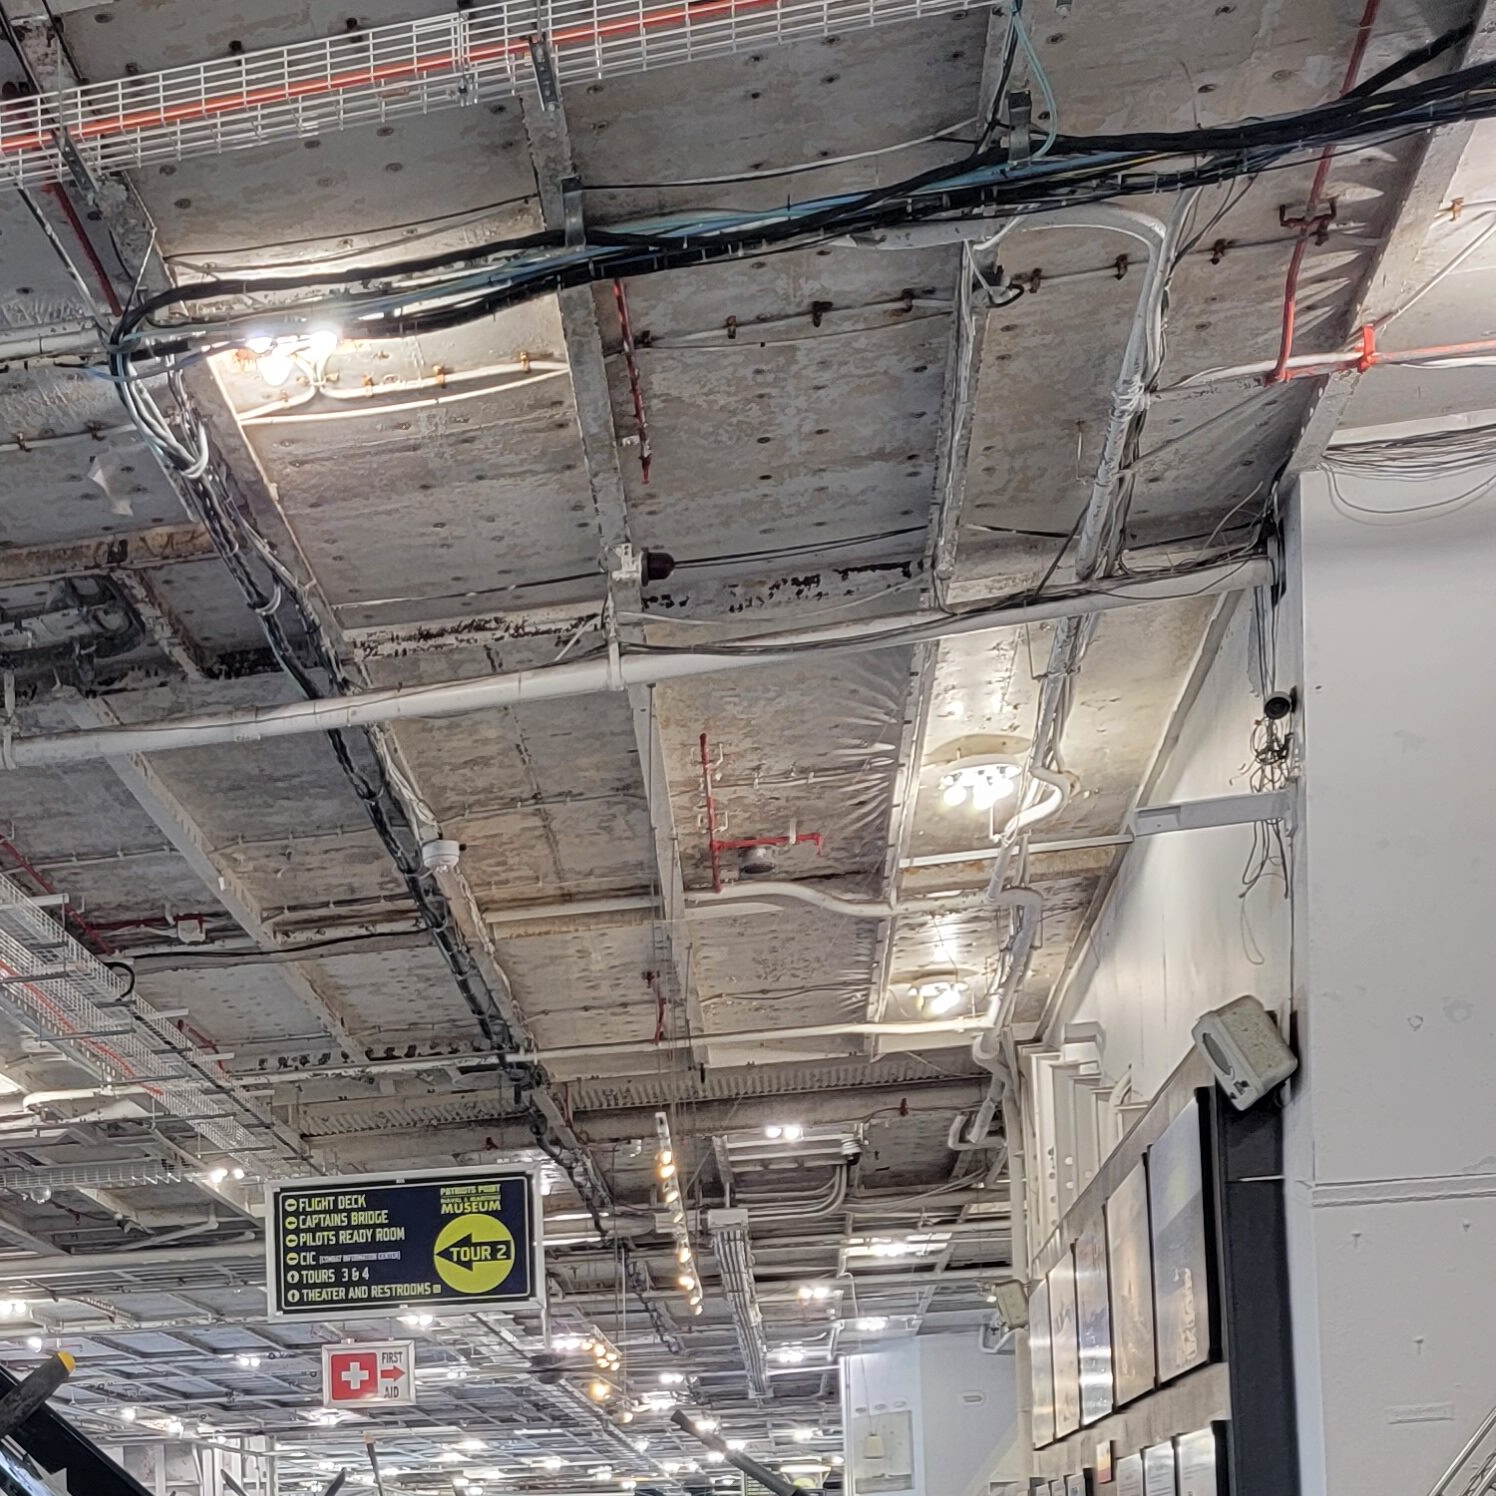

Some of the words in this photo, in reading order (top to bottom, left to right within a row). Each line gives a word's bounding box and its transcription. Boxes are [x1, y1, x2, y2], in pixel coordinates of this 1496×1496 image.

[298, 1197, 335, 1212] FLIGHT
[338, 1195, 366, 1209] DECK
[441, 1200, 501, 1214] MUSEUM
[299, 1213, 347, 1229] CAPTAINS
[351, 1210, 389, 1226] BRIDGE
[299, 1231, 336, 1247] PILOTS
[339, 1229, 372, 1244] READY
[376, 1227, 405, 1241] ROOM
[300, 1251, 316, 1266] CIC
[450, 1246, 491, 1262] TOUR
[497, 1245, 507, 1259] 2
[301, 1269, 335, 1284] TOURS
[341, 1268, 348, 1281] 3
[351, 1268, 359, 1280] &
[362, 1266, 369, 1280] 4
[301, 1287, 346, 1302] THEATER
[348, 1285, 368, 1299] AND
[371, 1282, 431, 1297] RESTROOMS
[381, 1352, 403, 1364] FIRST
[384, 1387, 399, 1398] AID
